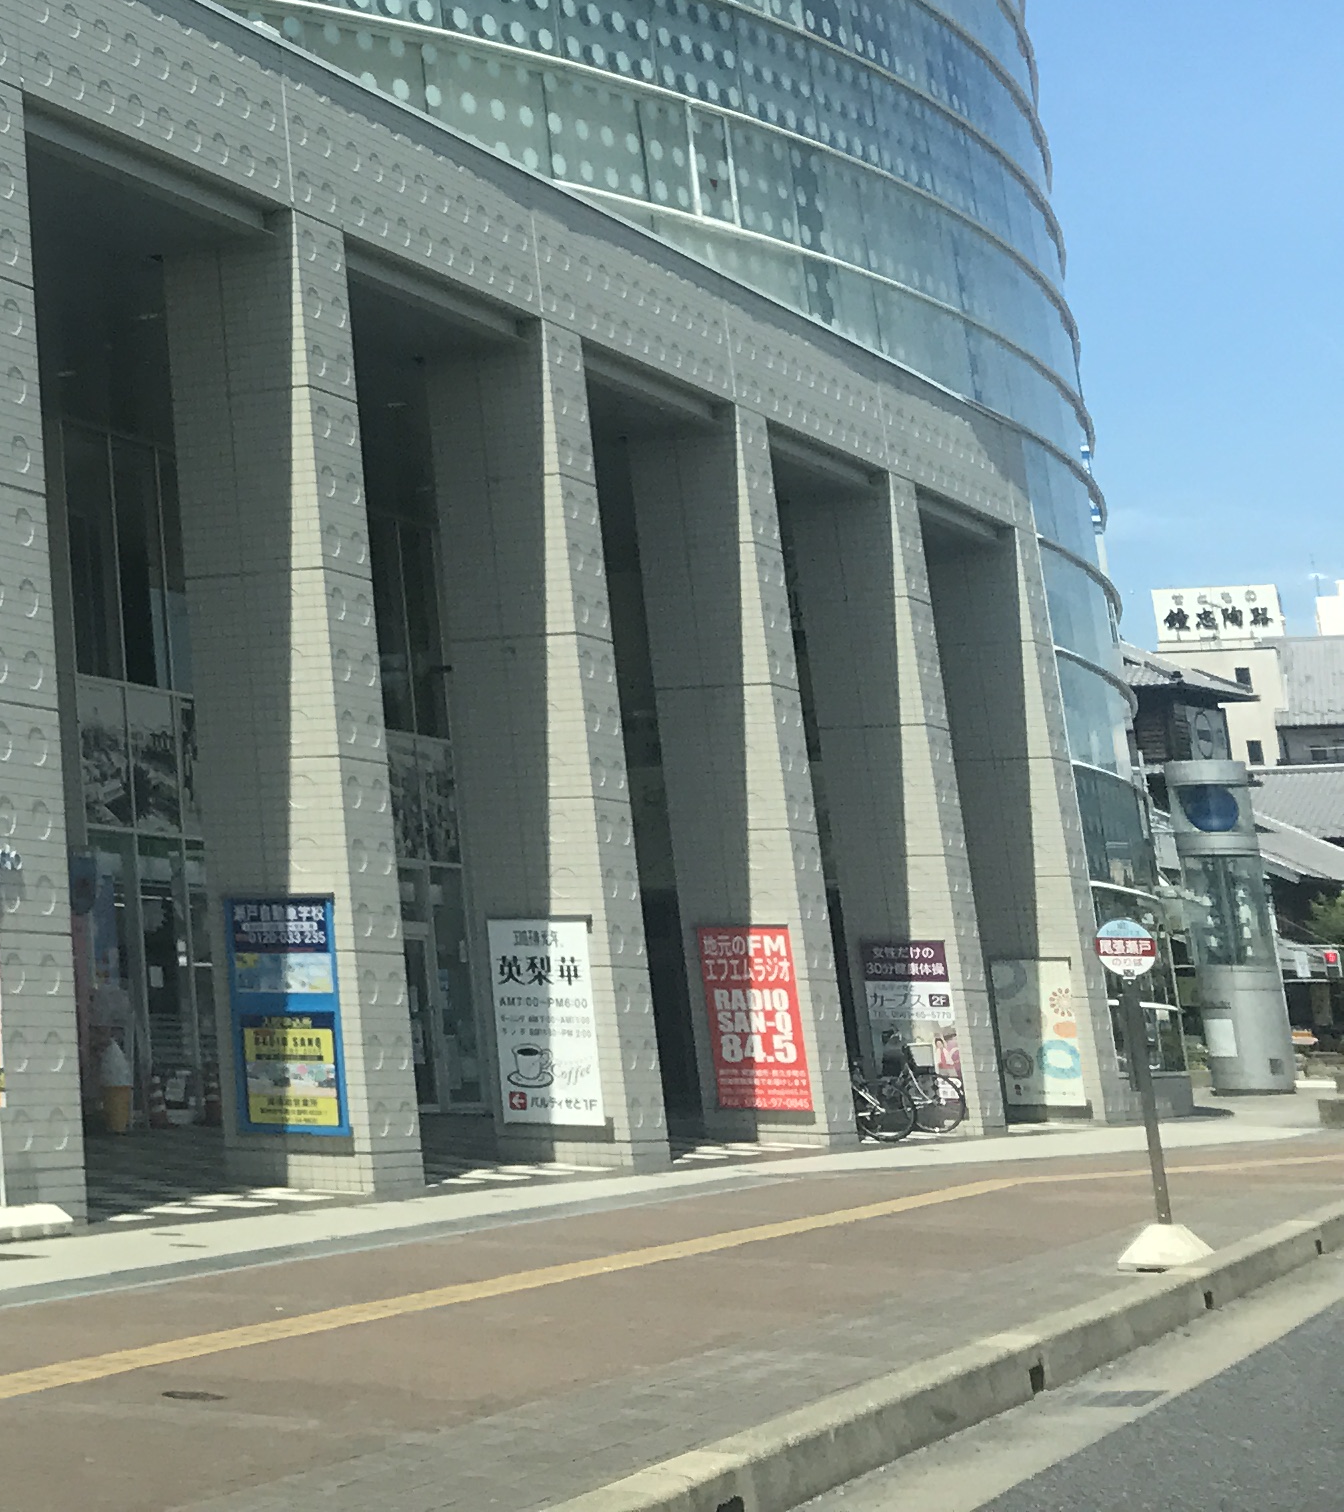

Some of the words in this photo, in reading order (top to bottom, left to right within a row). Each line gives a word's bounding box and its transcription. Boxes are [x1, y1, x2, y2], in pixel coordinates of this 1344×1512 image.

[703, 935, 788, 957] 地元のFM
[872, 946, 935, 959] 女性だけの
[1099, 939, 1151, 955] 尾張瀬戸
[705, 958, 791, 982] エフエムラジオ
[714, 988, 789, 1011] RADIO
[931, 996, 947, 1006] 2F
[717, 1011, 793, 1035] SAN-Q
[721, 1033, 797, 1063] 84.5
